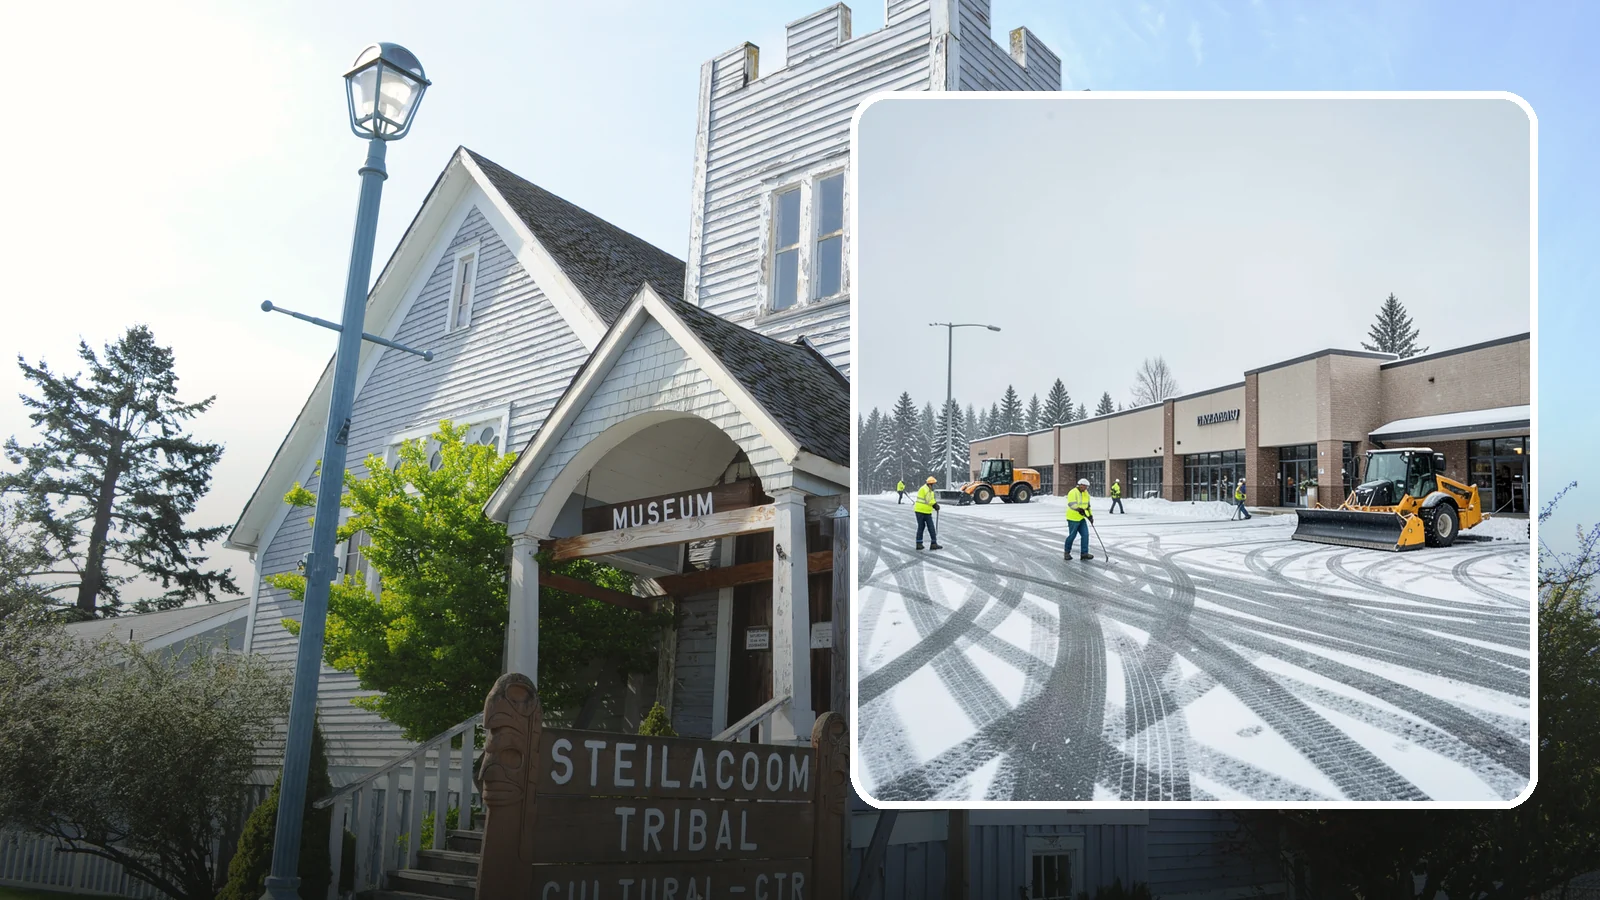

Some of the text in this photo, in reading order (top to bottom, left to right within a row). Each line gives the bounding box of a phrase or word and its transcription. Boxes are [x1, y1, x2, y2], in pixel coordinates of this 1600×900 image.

[613, 491, 714, 531] MUSEUM
[550, 738, 810, 793] STEILACOOM
[614, 806, 758, 852] TRIBAL
